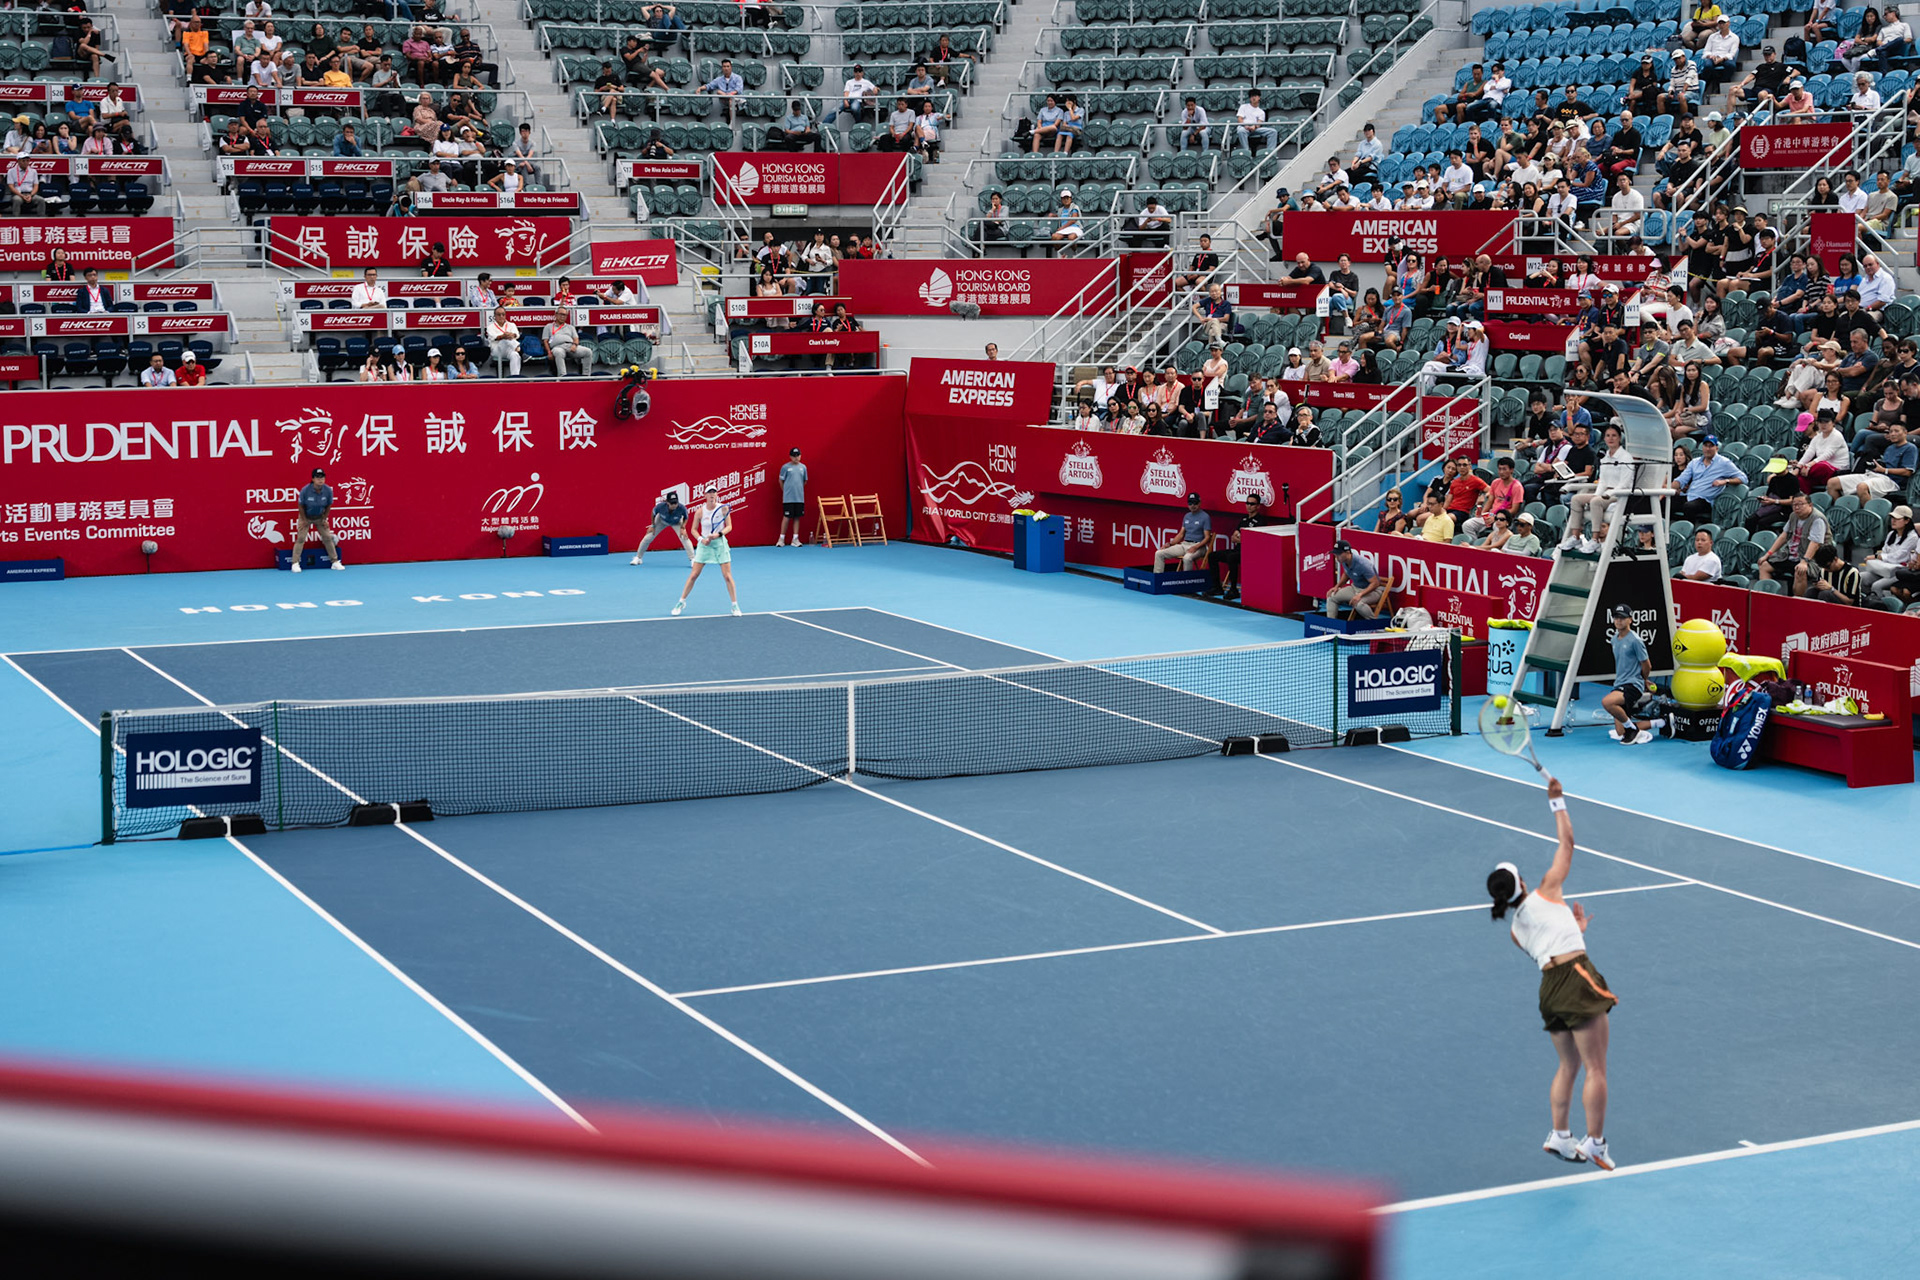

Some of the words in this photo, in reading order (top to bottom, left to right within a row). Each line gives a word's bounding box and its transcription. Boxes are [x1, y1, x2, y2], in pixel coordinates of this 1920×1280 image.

[762, 164, 792, 174] HONG
[795, 163, 825, 173] KONG
[762, 184, 825, 194] 香港旅遊發展局
[1351, 220, 1437, 235] AMERICAN
[298, 224, 479, 260] 保誠保險
[611, 255, 669, 267] HKCTA
[956, 270, 992, 281] HONG
[994, 270, 1031, 281] KONG
[956, 282, 996, 292] TOURISM
[998, 282, 1031, 292] BOARD
[1506, 296, 1549, 305] PRUDENTIAL
[941, 370, 1015, 388] AMERICAN
[950, 388, 1014, 406] EXPRESS
[354, 408, 598, 456] 保誠保險
[2, 418, 273, 464] PRUDENTIAL
[989, 458, 1016, 473] KON
[1068, 461, 1094, 471] STELLA
[744, 470, 765, 489] 計劃
[1068, 470, 1094, 480] ARTOIS
[1150, 469, 1176, 479] STELLA
[1150, 478, 1177, 488] ARTOIS
[1237, 477, 1265, 487] STELLA
[332, 516, 370, 528] KONG
[481, 516, 539, 525] 大型體育活動
[972, 511, 989, 521] CITY
[24, 528, 80, 542] Events
[86, 524, 175, 539] Committee
[338, 529, 372, 540] OPEN
[179, 599, 364, 614] HONG
[411, 589, 586, 602] KONG
[1438, 611, 1474, 627] PRUDENTIAL
[1811, 628, 1849, 651] 政府資助
[1852, 632, 1870, 649] 計劃
[1355, 664, 1435, 688] HOLOGIC
[1820, 682, 1870, 702] PRUDENTIAL
[1747, 706, 1768, 740] YONEX
[136, 747, 252, 773] HOLOGIC
